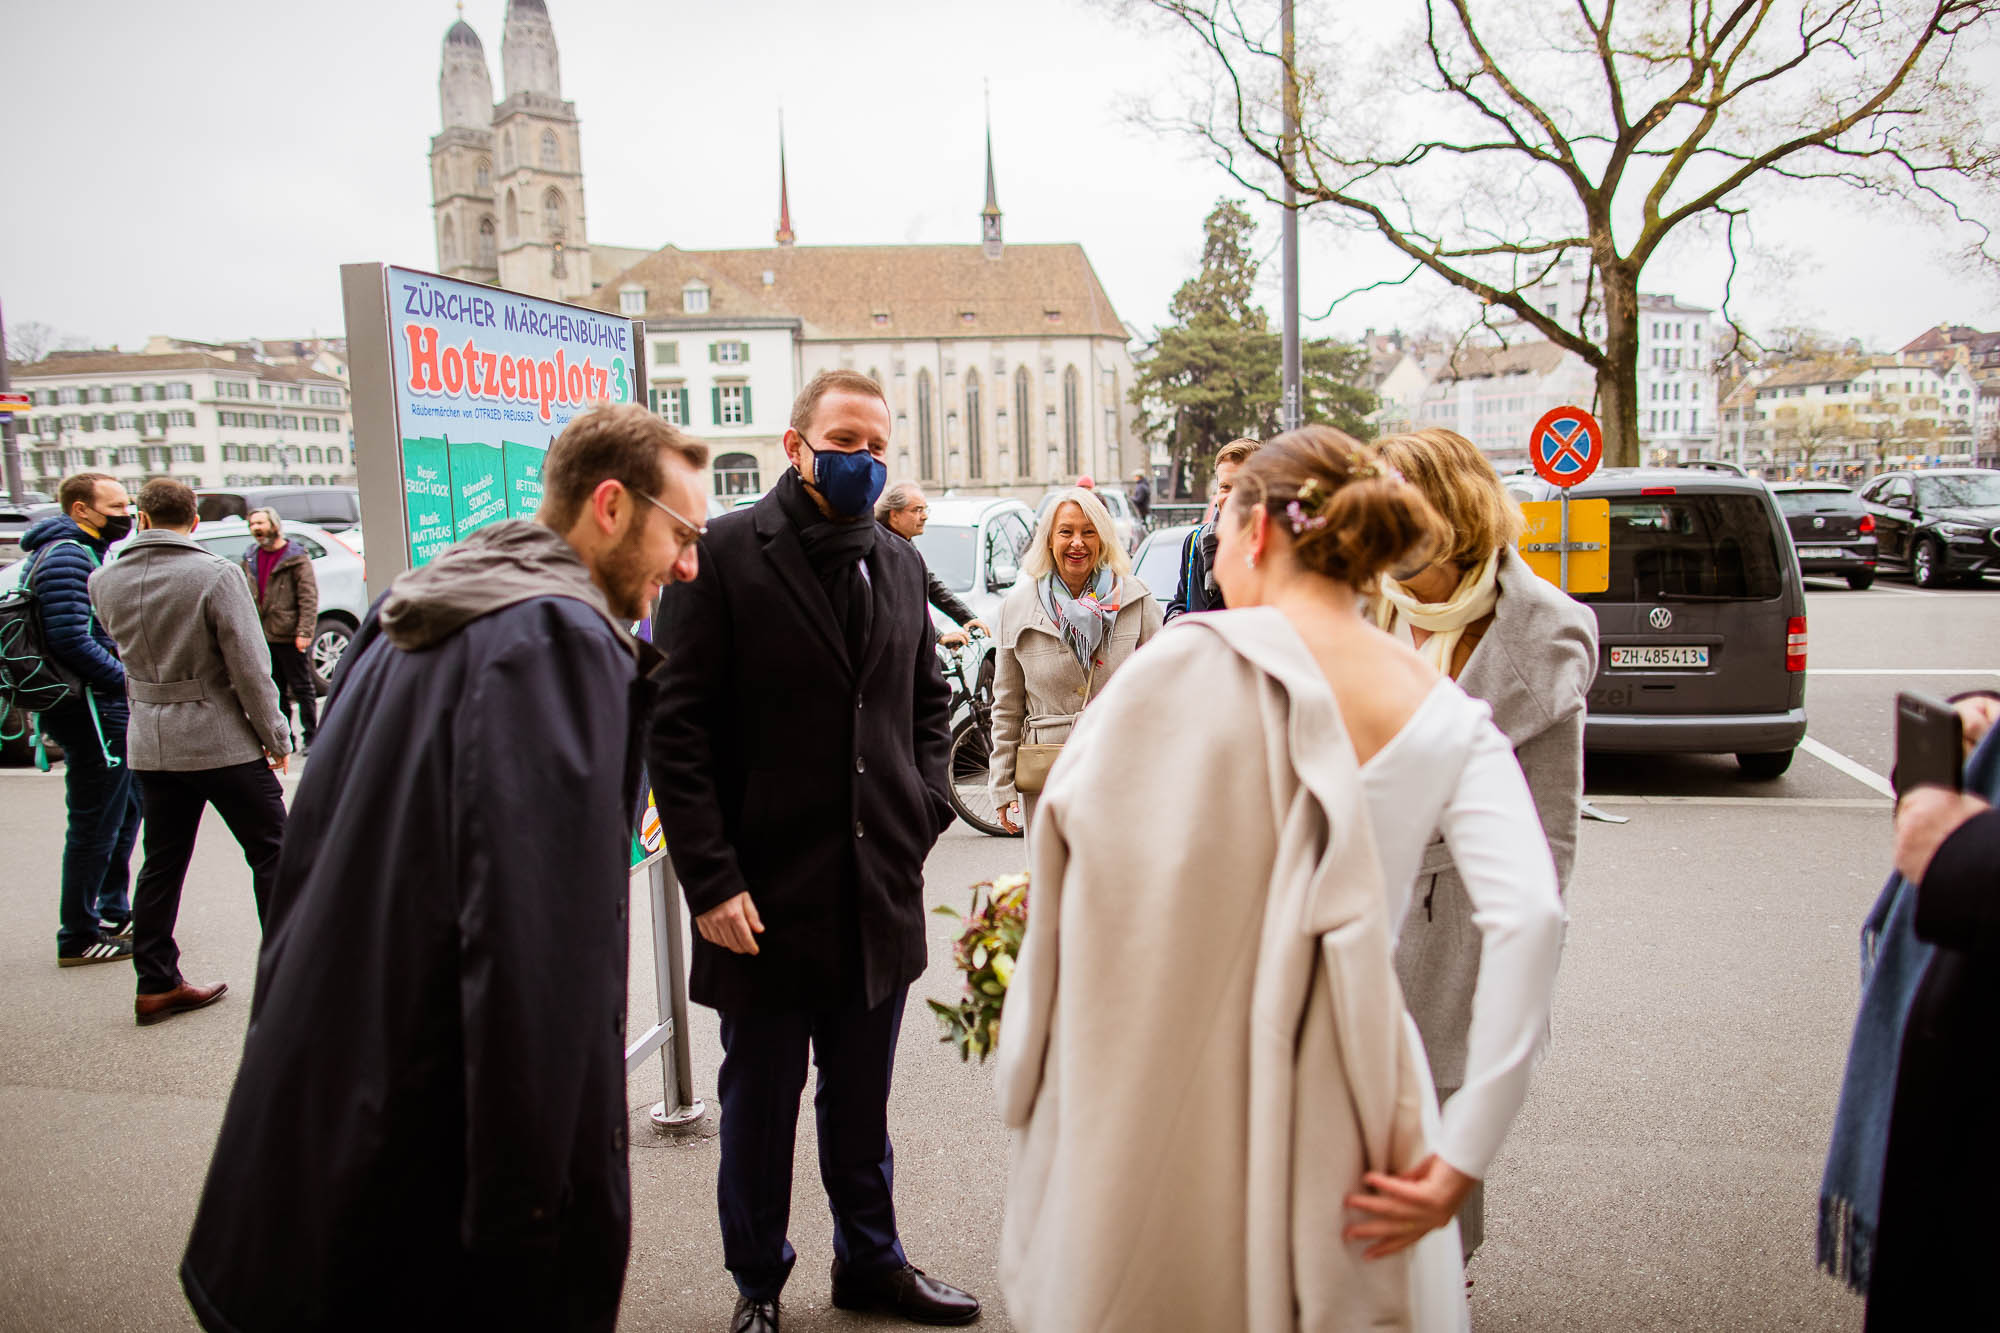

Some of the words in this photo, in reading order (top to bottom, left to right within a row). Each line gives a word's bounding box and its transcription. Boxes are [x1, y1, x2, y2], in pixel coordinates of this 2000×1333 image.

[402, 281, 497, 328] ZÜRCHER
[504, 302, 628, 352] MÄRCHENBÜHNE
[405, 323, 611, 420] Hotzenplotz
[612, 356, 629, 403] 3
[411, 403, 461, 418] Räubermärchen
[462, 409, 473, 419] von
[474, 407, 502, 421] OTFRIED
[503, 411, 534, 423] PREUSSLER
[406, 478, 430, 495] ERICH
[430, 482, 449, 497] VOCK
[468, 490, 492, 511] SIMON
[412, 525, 451, 544] MATTHIAS
